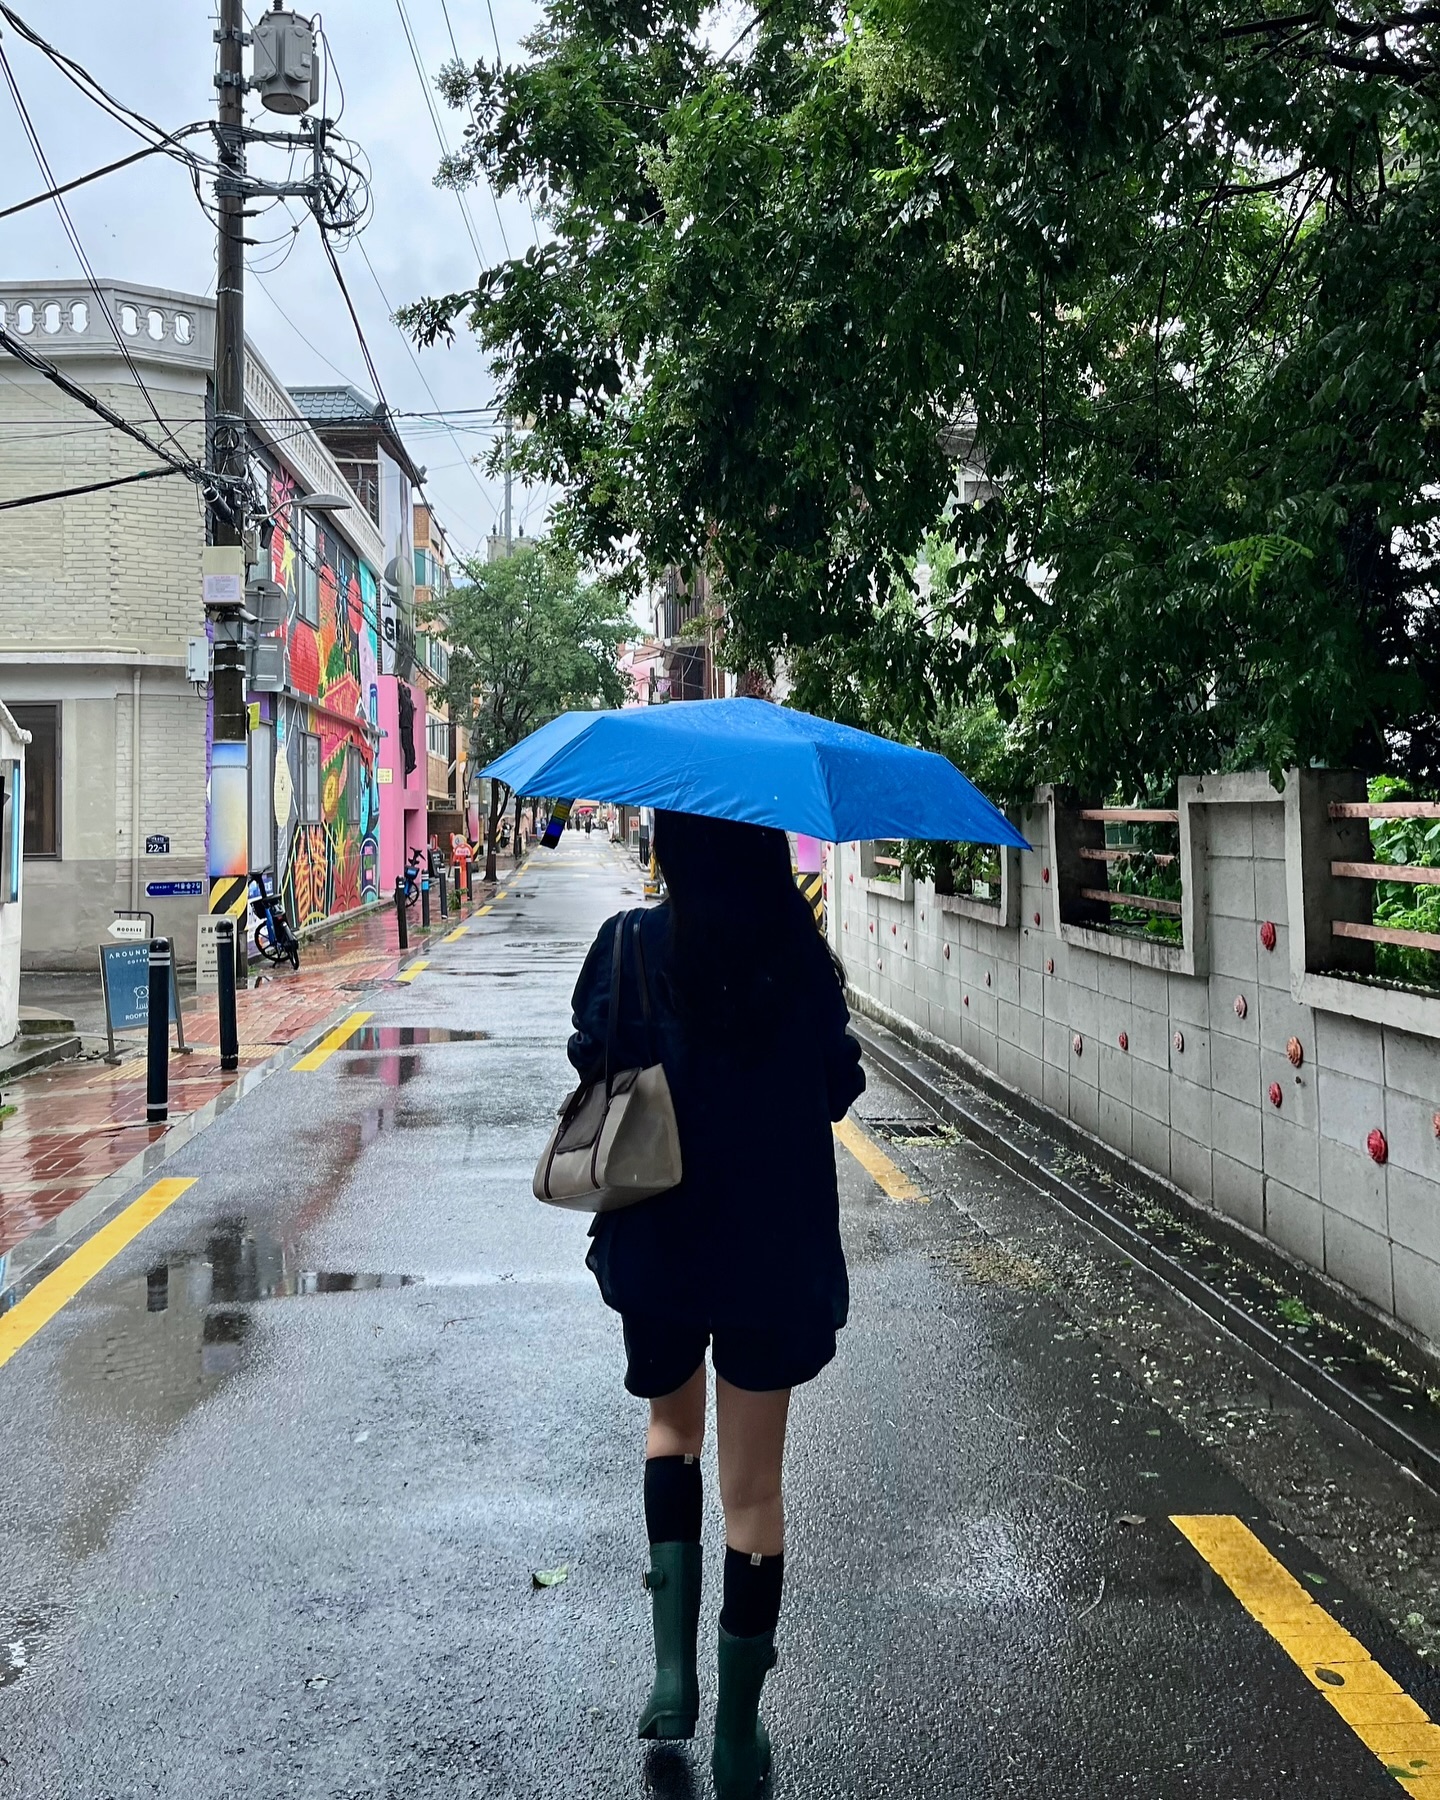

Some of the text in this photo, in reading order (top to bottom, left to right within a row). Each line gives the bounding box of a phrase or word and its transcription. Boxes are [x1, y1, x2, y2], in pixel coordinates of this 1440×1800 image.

[148, 843, 167, 853] 22-1
[109, 948, 148, 960] AROUND
[125, 1011, 149, 1021] ROOFTO
